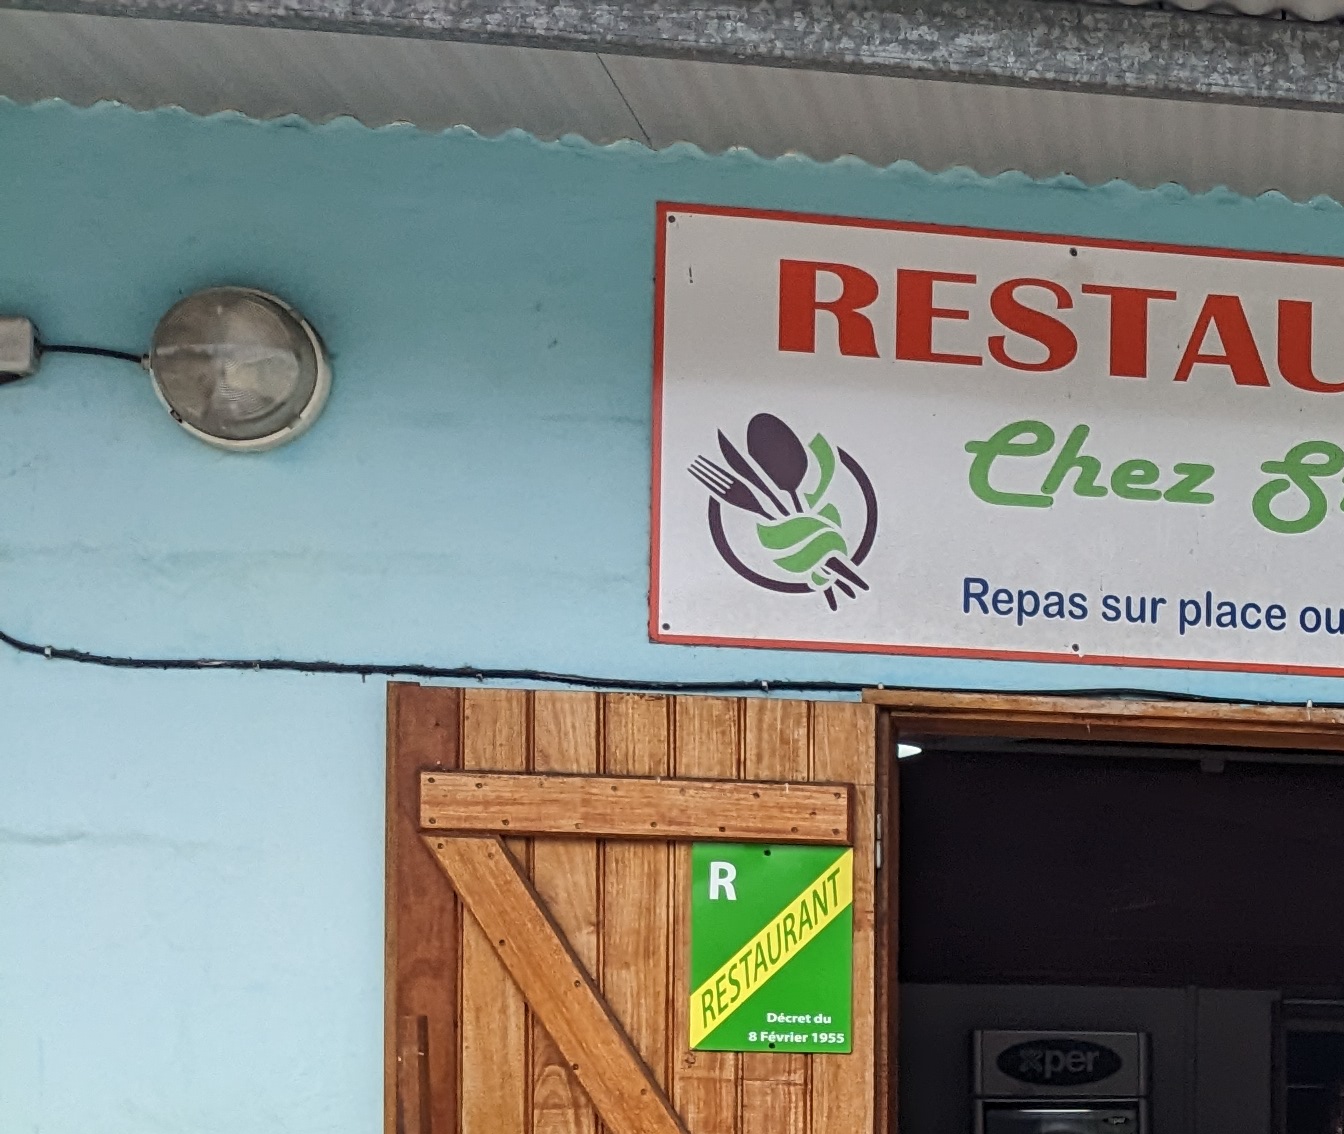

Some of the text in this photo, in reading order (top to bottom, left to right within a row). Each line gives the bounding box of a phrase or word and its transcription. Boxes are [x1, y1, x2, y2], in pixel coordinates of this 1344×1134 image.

[966, 421, 1213, 507] Chez
[963, 578, 1089, 625] Repas
[1101, 592, 1167, 624] sur
[1179, 591, 1287, 635] place
[709, 861, 737, 900] R
[701, 867, 840, 1029] RESTAURANT
[748, 1032, 844, 1043] 8 Février 1955
[767, 1013, 831, 1024] Décret du
